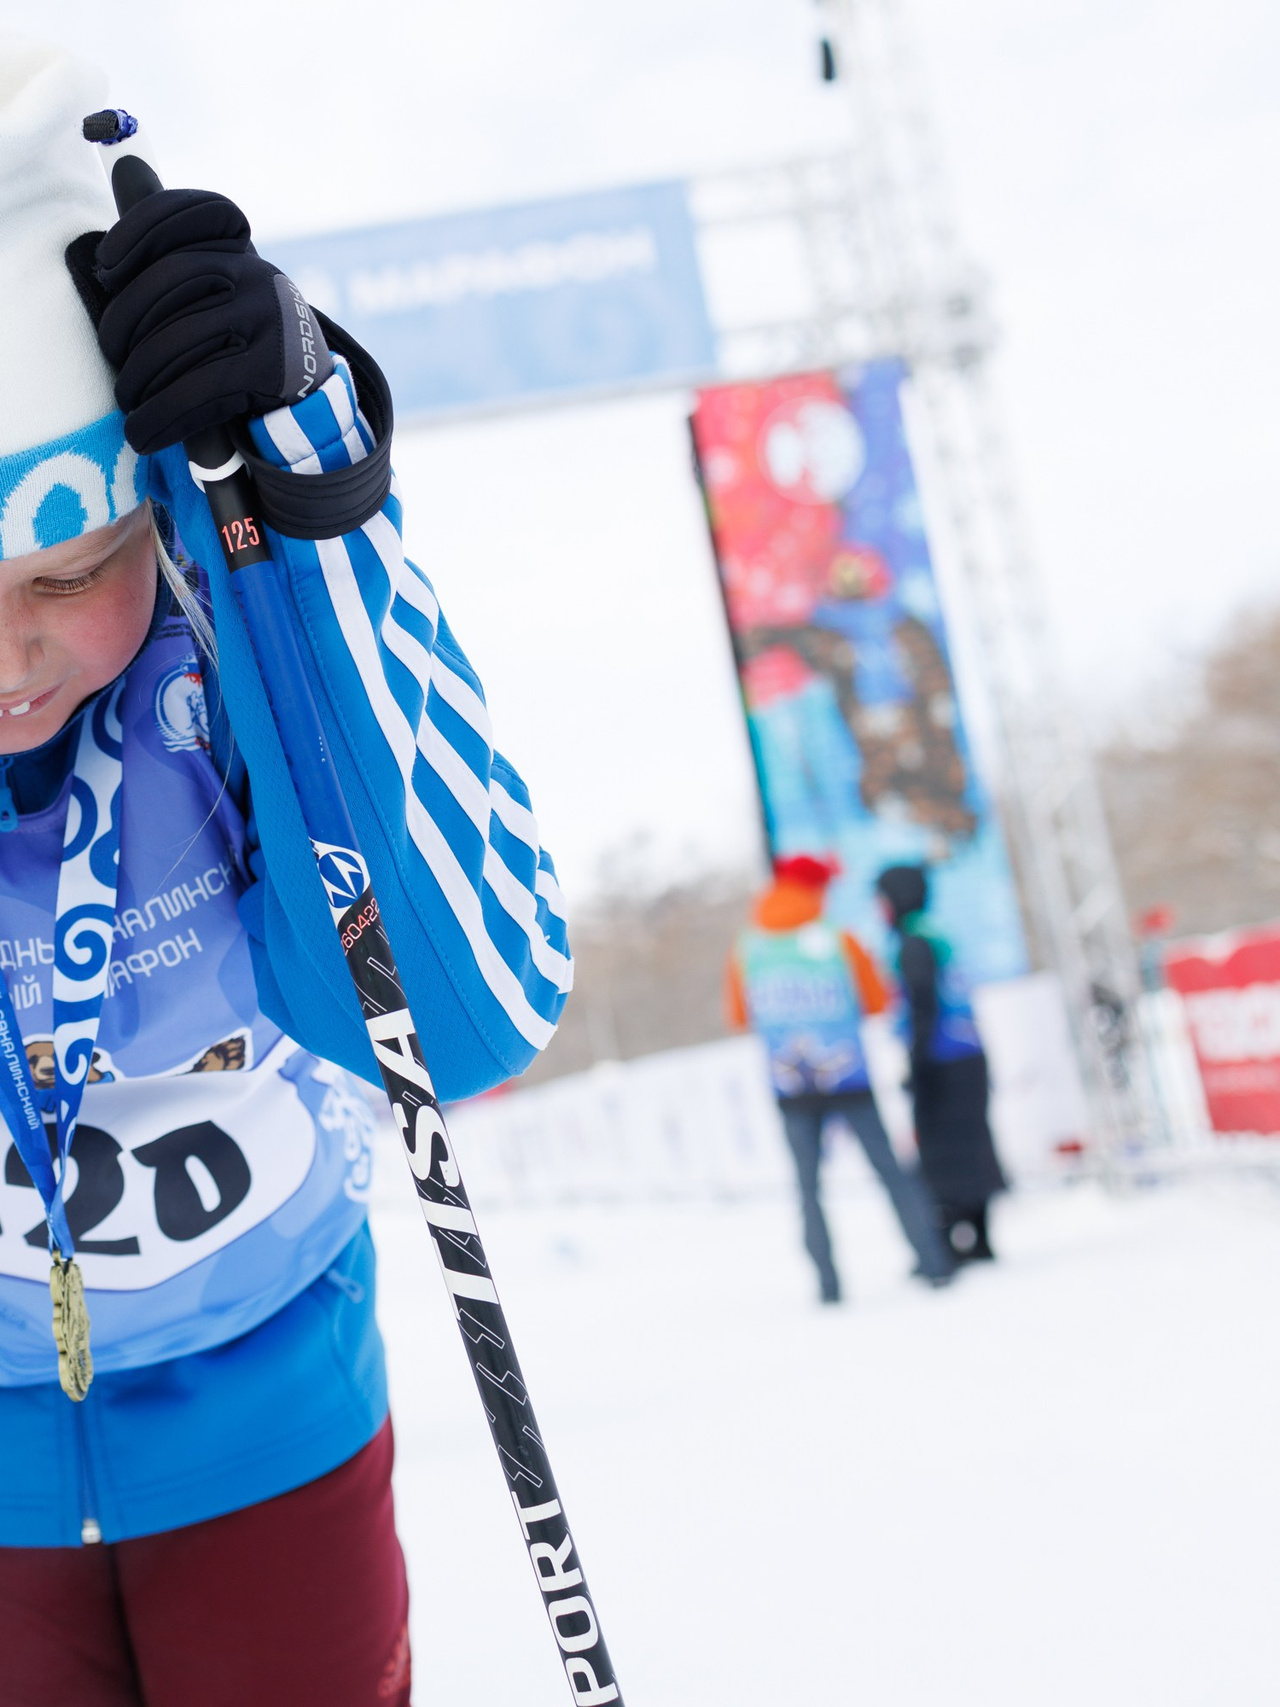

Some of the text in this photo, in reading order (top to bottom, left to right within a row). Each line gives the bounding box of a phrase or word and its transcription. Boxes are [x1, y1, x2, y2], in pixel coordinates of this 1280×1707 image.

[288, 282, 317, 398] NORDSKI
[221, 517, 260, 553] 125
[364, 1007, 500, 1321] TISA
